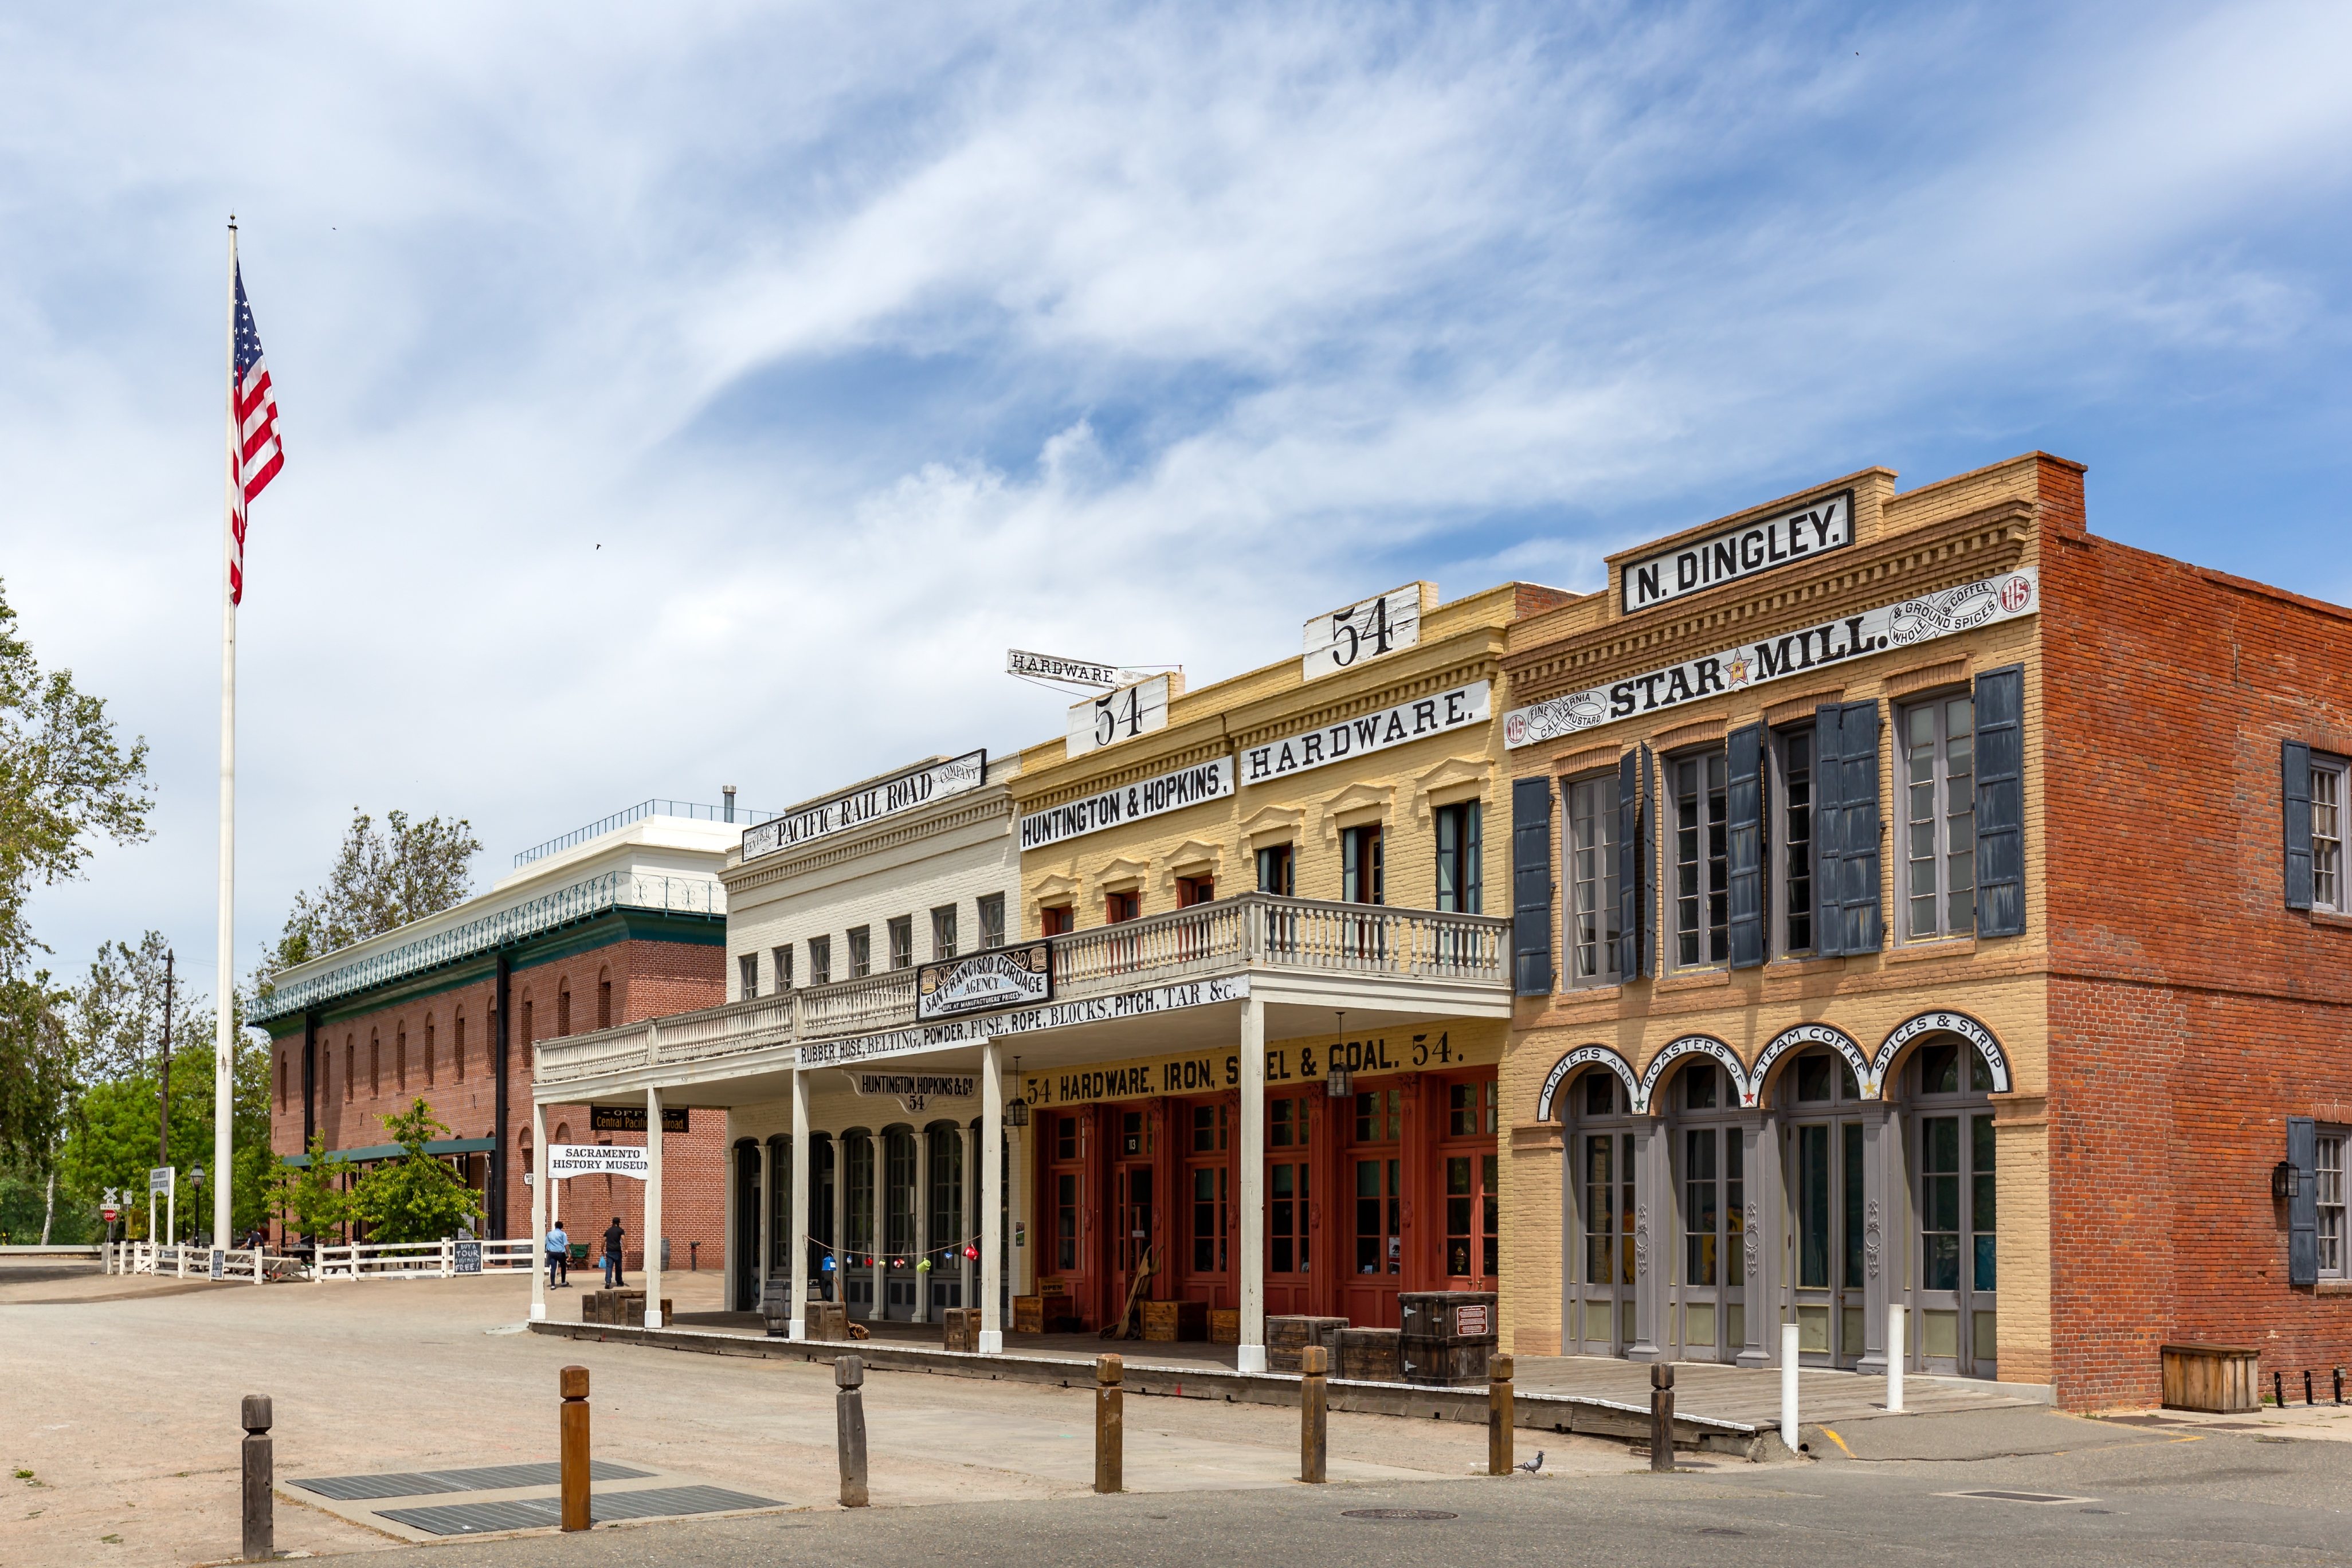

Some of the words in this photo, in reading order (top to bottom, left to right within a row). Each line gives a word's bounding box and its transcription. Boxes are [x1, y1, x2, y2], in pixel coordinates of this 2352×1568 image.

[1638, 563, 1667, 603] N.
[1677, 504, 1839, 591] DINGLEY.
[1894, 607, 1903, 619] &
[1906, 602, 1950, 628] GROUND
[1954, 601, 1995, 629] SPICES
[1942, 607, 1953, 616] &
[1950, 582, 1989, 607] COFFEE
[1332, 597, 1393, 666] 54
[1893, 620, 1927, 643] WHOLE
[1012, 654, 1115, 684] HARDWARE.
[1610, 657, 1725, 719] STAR
[1754, 616, 1888, 681] MILL.
[1095, 687, 1142, 746] 54
[1249, 690, 1473, 780] HARDWARE.
[1530, 705, 1549, 720] FINE
[1540, 693, 1590, 738] CALIFORNIA
[1565, 710, 1601, 726] MUSTARD
[746, 827, 771, 853] CENTRAL
[777, 807, 833, 846] PACIFIC
[841, 791, 881, 826] RAIL
[886, 773, 932, 812] ROAD
[940, 765, 979, 784] COMPANY
[1022, 792, 1119, 847] HUNTINGTON
[1127, 787, 1139, 818] &
[1144, 764, 1227, 814] HOPKINS,
[926, 991, 943, 1012] SAN
[945, 956, 993, 998] FRANCISCO
[997, 957, 1042, 993] CORDAGE
[961, 995, 1001, 1008] MANUFACTURERS'
[1002, 992, 1019, 1001] PRICES
[965, 976, 999, 994] AGENCY
[801, 1043, 835, 1063] RUBBER
[840, 1038, 866, 1059] HOSE,
[867, 1029, 921, 1053] BELTING,
[924, 1023, 967, 1045] POWDER,
[970, 1016, 1008, 1039] FUSE,
[1012, 1010, 1046, 1032] ROPE,
[1049, 999, 1112, 1026] BLOCKS,
[1115, 991, 1159, 1016] PITCH,
[1164, 983, 1201, 1008] TAR
[1875, 1017, 1927, 1073] SPICES
[1937, 1014, 1950, 1026] &
[1957, 1020, 2002, 1068] SYRUP
[1027, 1079, 1051, 1105] 54
[1060, 1067, 1155, 1101] HARDWARE,
[1164, 1059, 1215, 1091] IRON,
[1226, 1050, 1291, 1084] SEL
[1300, 1048, 1316, 1077] &
[1329, 1039, 1399, 1072] COAL.
[1412, 1032, 1464, 1066] 54.
[1544, 1049, 1600, 1100] MAKERS
[1607, 1057, 1632, 1087] AND
[1644, 1039, 1726, 1089] ROASTERS
[1730, 1063, 1744, 1084] OF
[1754, 1030, 1801, 1082] STEAM
[1809, 1028, 1865, 1075] COFFEE
[862, 1075, 916, 1095] HUNTINGTON,
[917, 1077, 952, 1095] HOPKINS
[955, 1077, 962, 1095] &
[909, 1095, 924, 1110] 54
[597, 1116, 622, 1128] Central
[662, 1118, 685, 1129] ilroad.
[552, 1160, 602, 1169] HISTORY
[566, 1148, 640, 1158] SACRAMENTO
